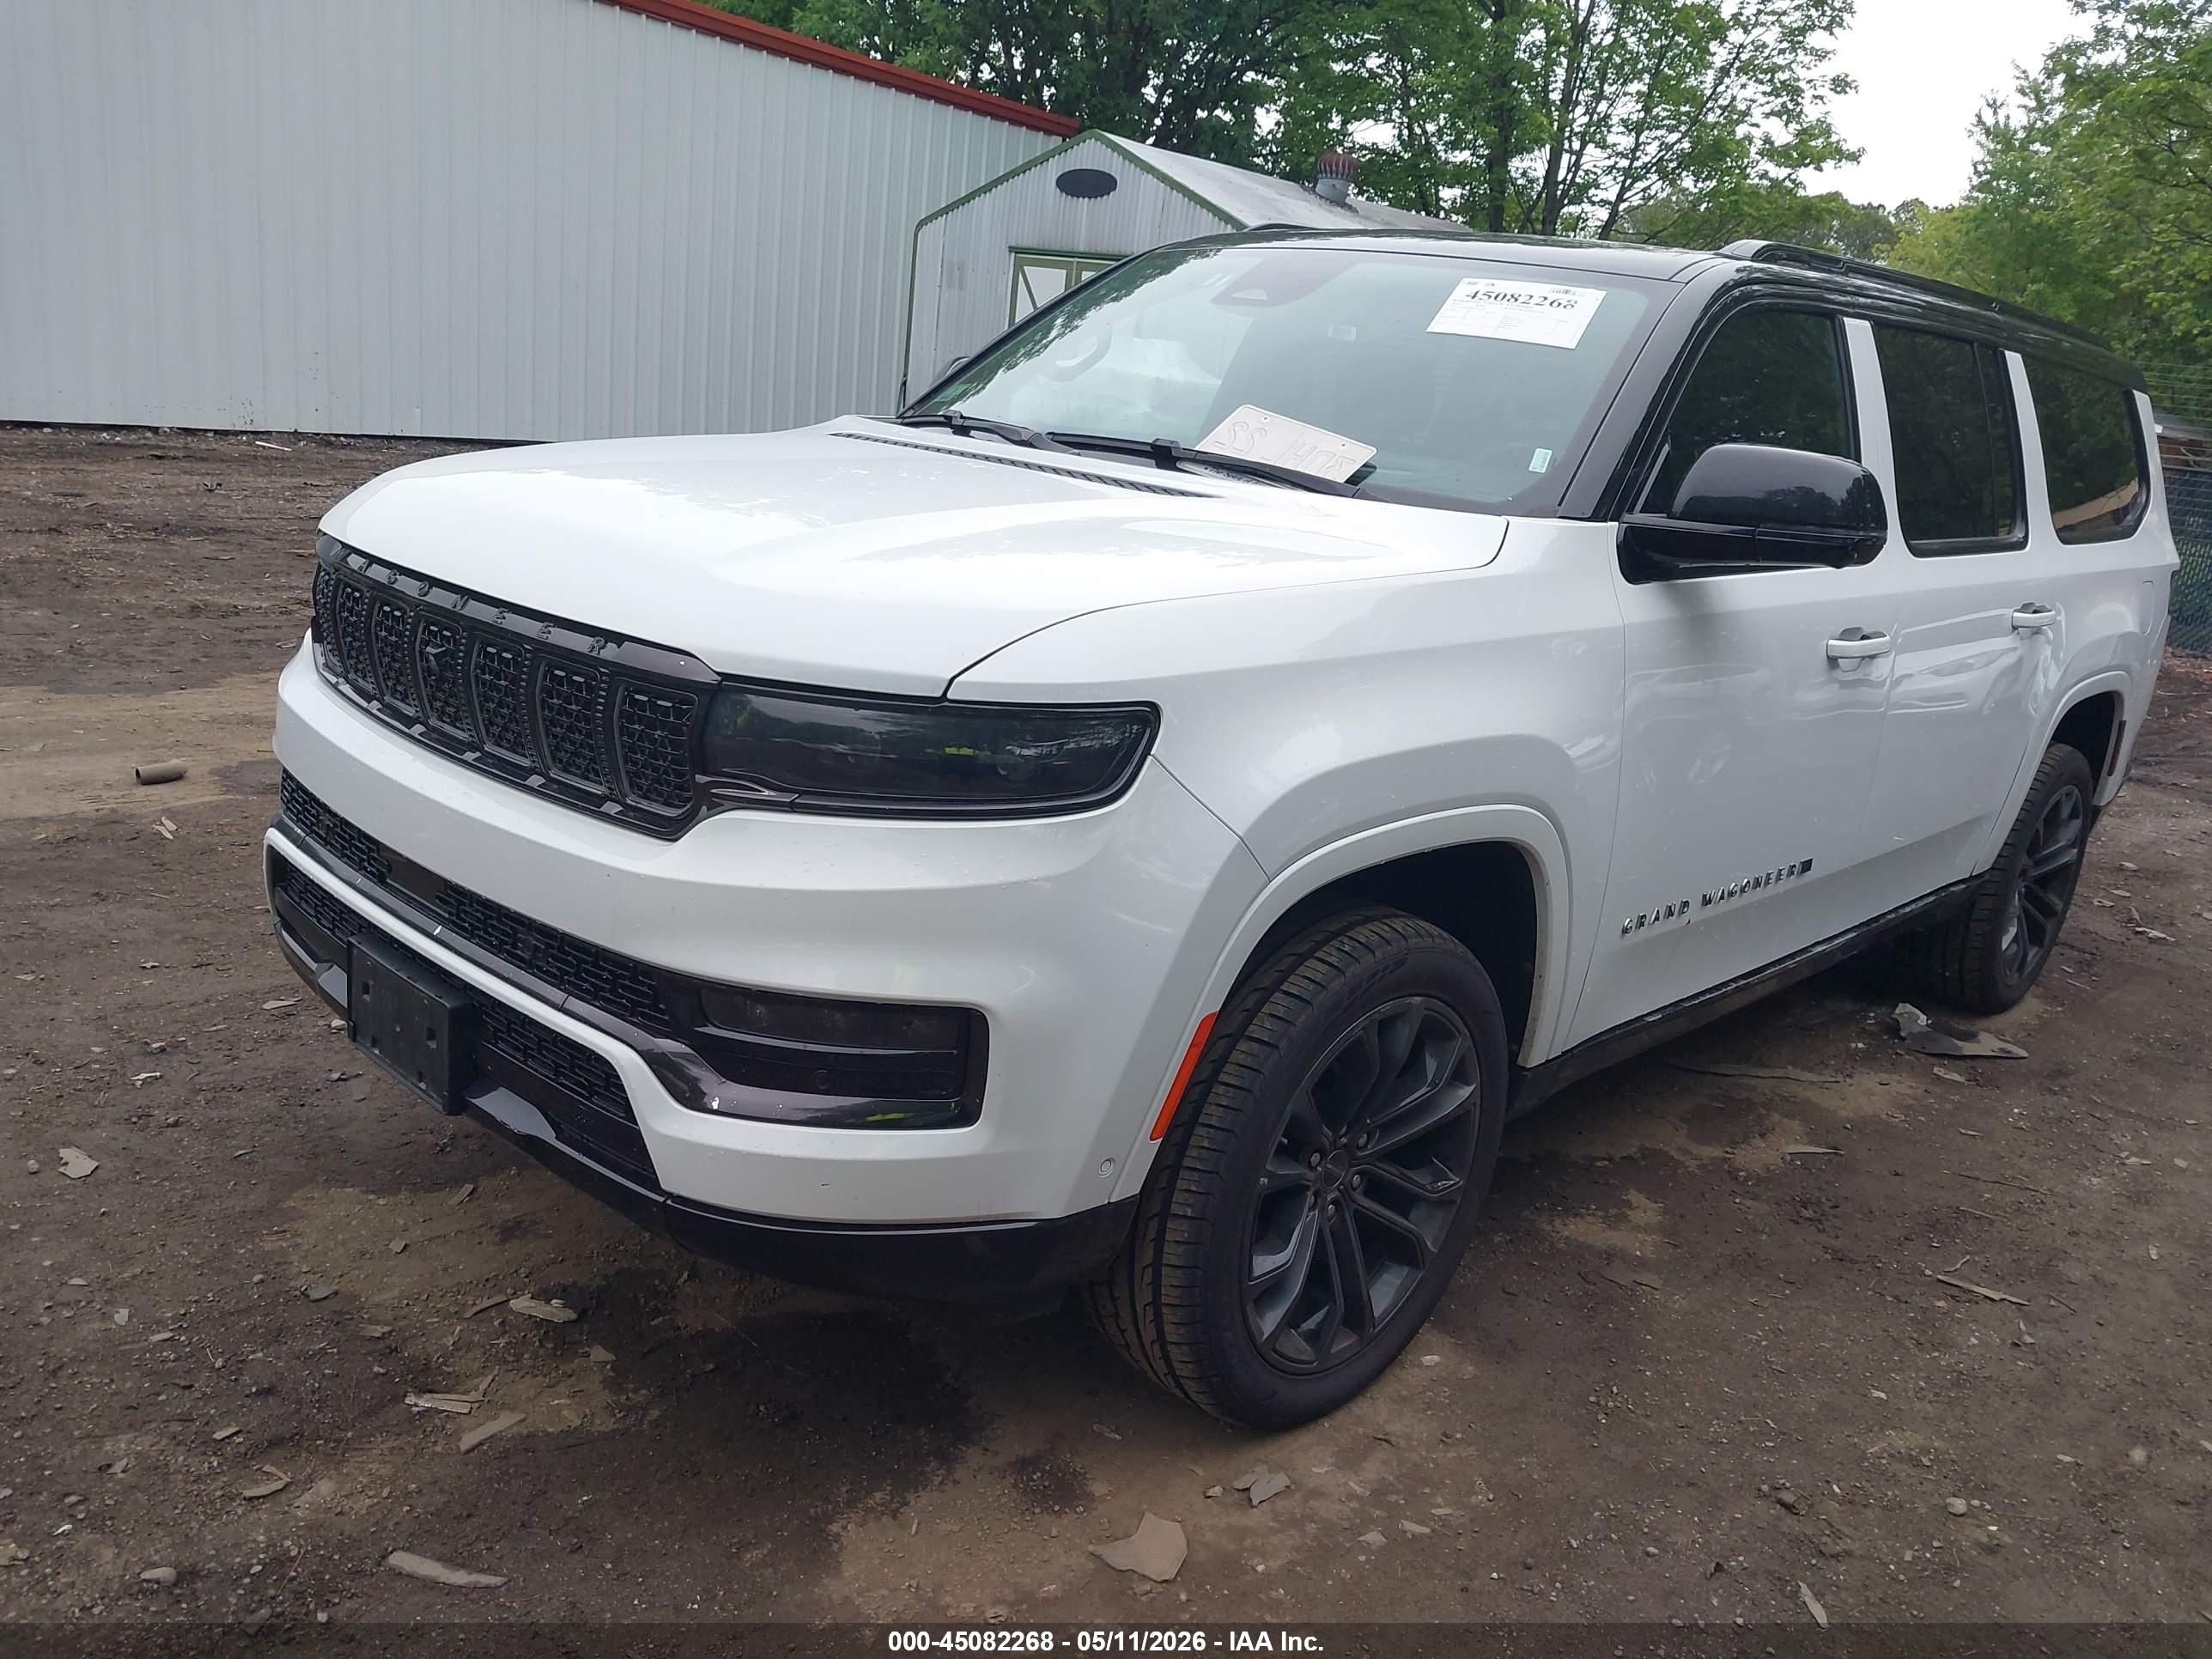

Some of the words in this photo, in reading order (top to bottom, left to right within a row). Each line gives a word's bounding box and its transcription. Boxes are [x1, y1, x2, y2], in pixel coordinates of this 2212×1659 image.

[1465, 289, 1578, 310] 45082268
[331, 547, 607, 655] WAGONEER
[1621, 899, 1691, 935] GRAND
[1700, 862, 1798, 908] WAGONEER
